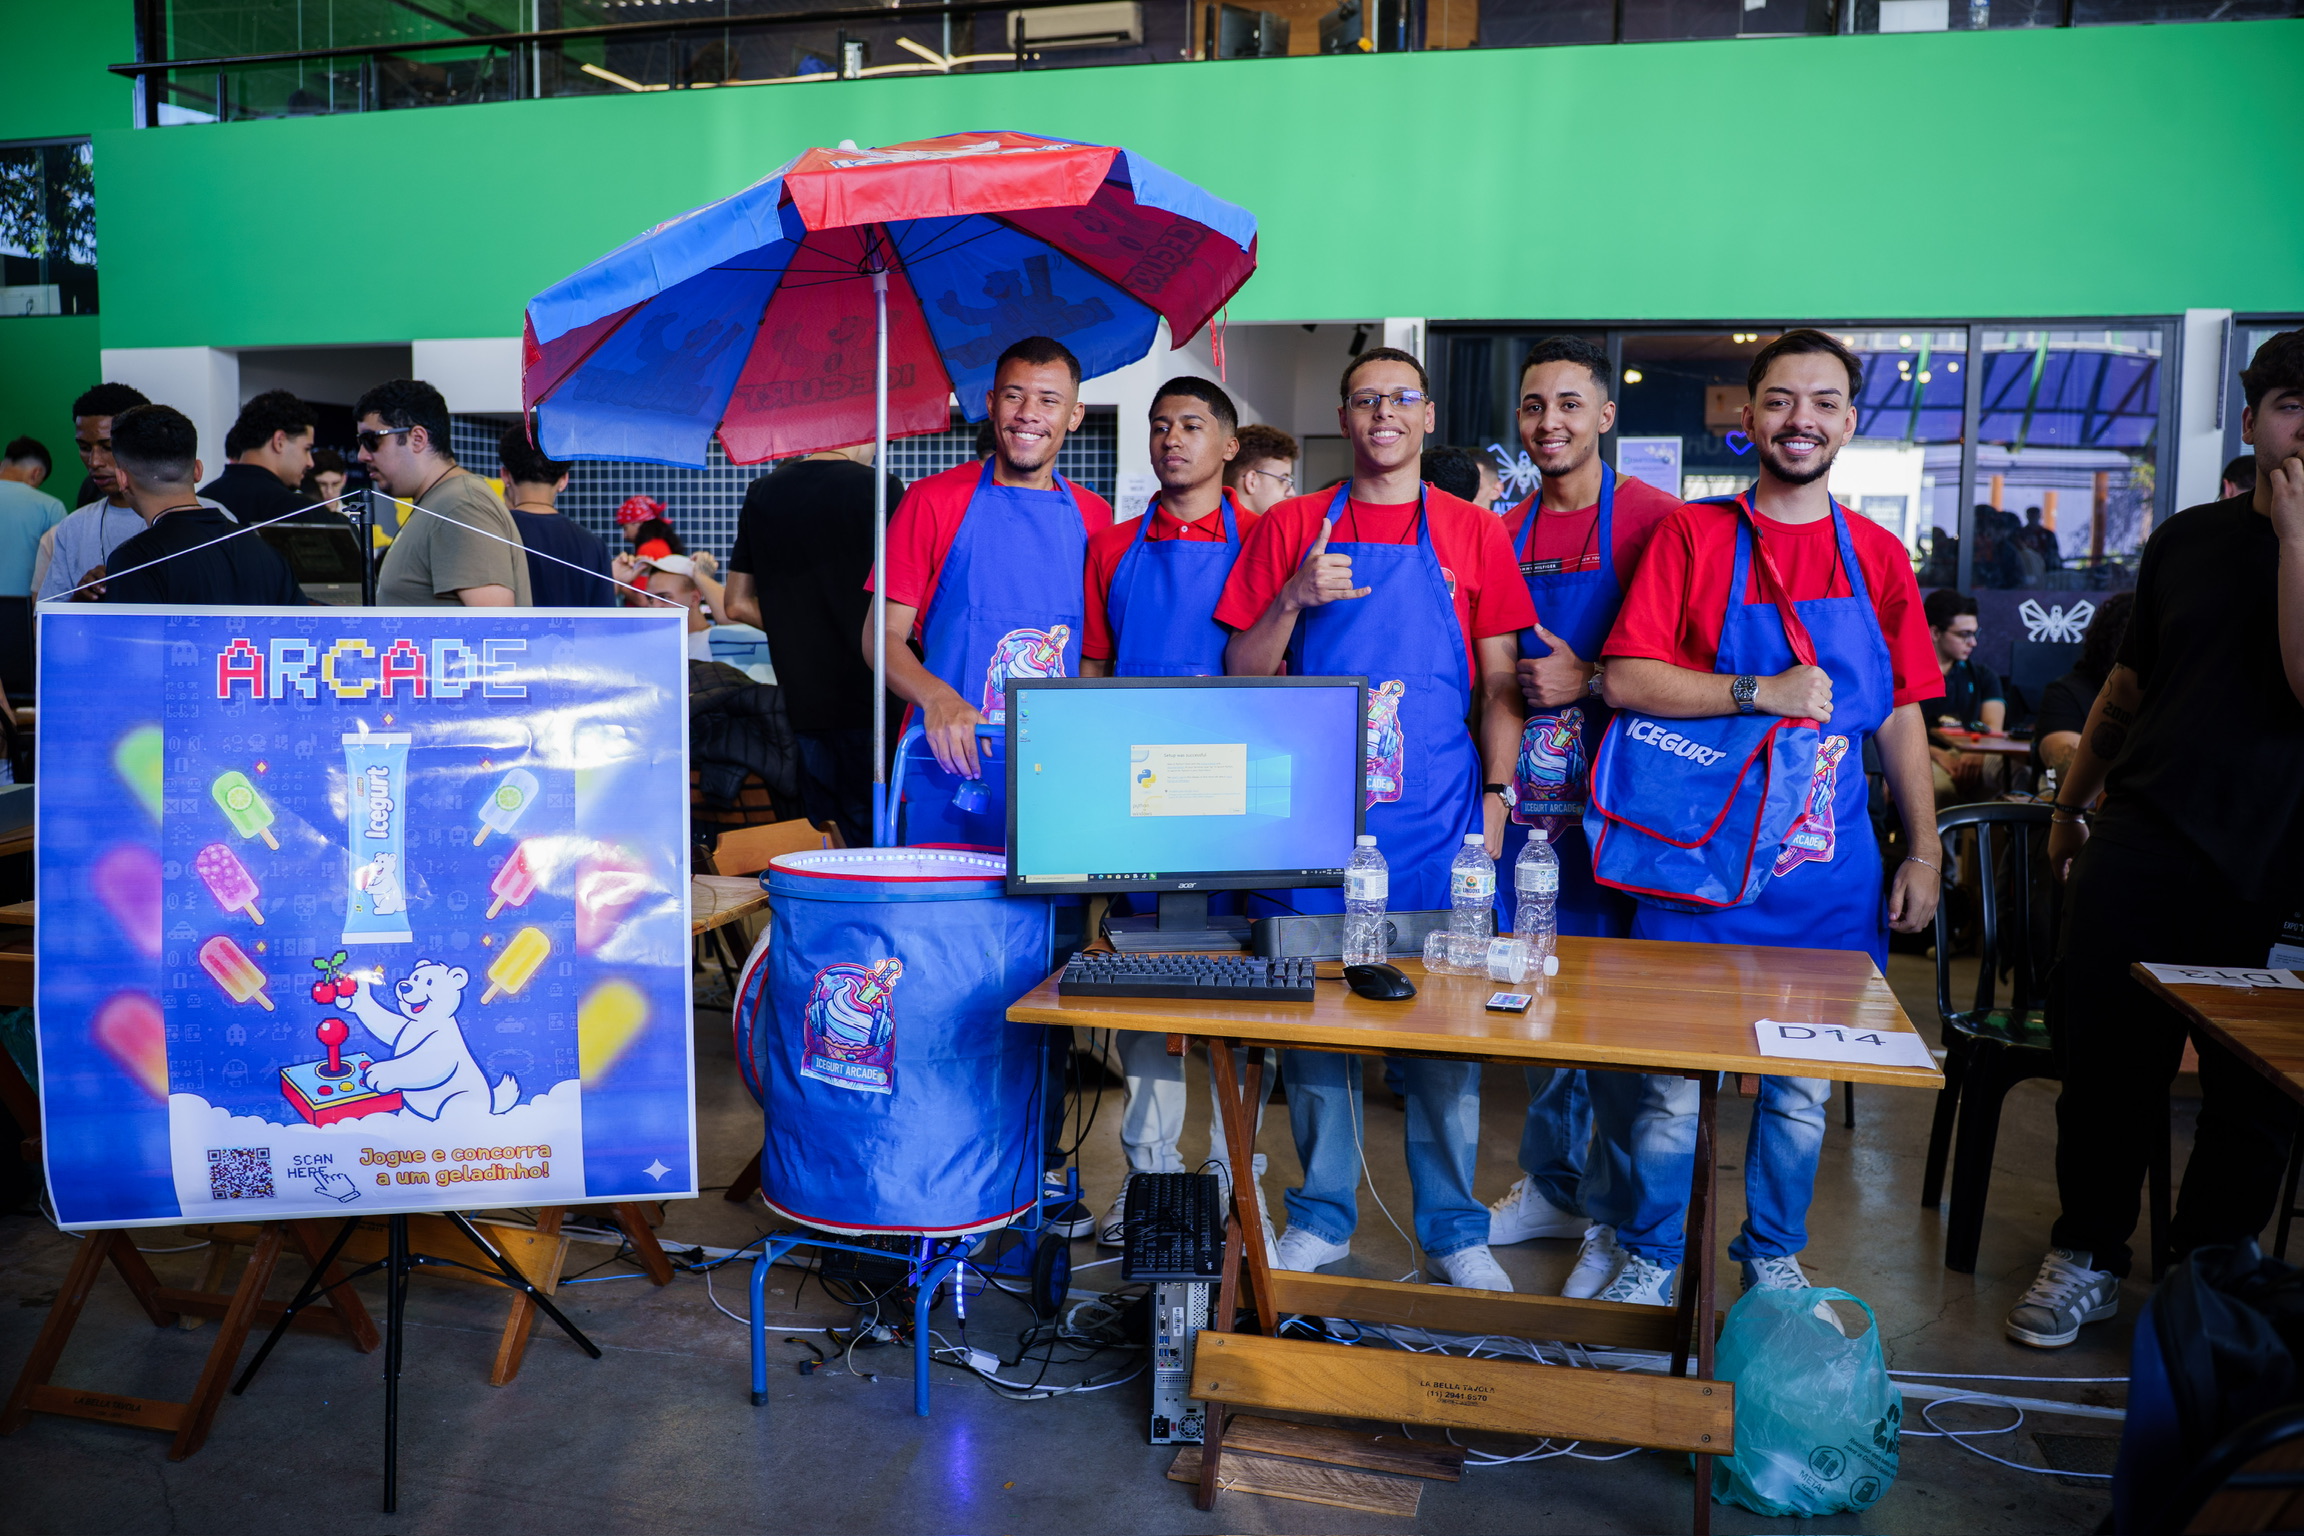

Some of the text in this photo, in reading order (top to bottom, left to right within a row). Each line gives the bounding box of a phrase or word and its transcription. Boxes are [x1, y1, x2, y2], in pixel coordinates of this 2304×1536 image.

[217, 638, 527, 698] ARCADE
[1625, 717, 1727, 767] ICEGURT
[364, 765, 394, 839] Icegurt
[1524, 803, 1576, 813] ICEGURT ARCADE
[1778, 1025, 1886, 1046] D14
[816, 1057, 878, 1080] ICEGURT ARCADE
[293, 1153, 333, 1166] SCAN
[360, 1145, 551, 1168] Jogue e concorra
[376, 1161, 550, 1187] a um geladinho!
[1433, 1381, 1460, 1390] BELLA
[1798, 1470, 1826, 1495] METAL
